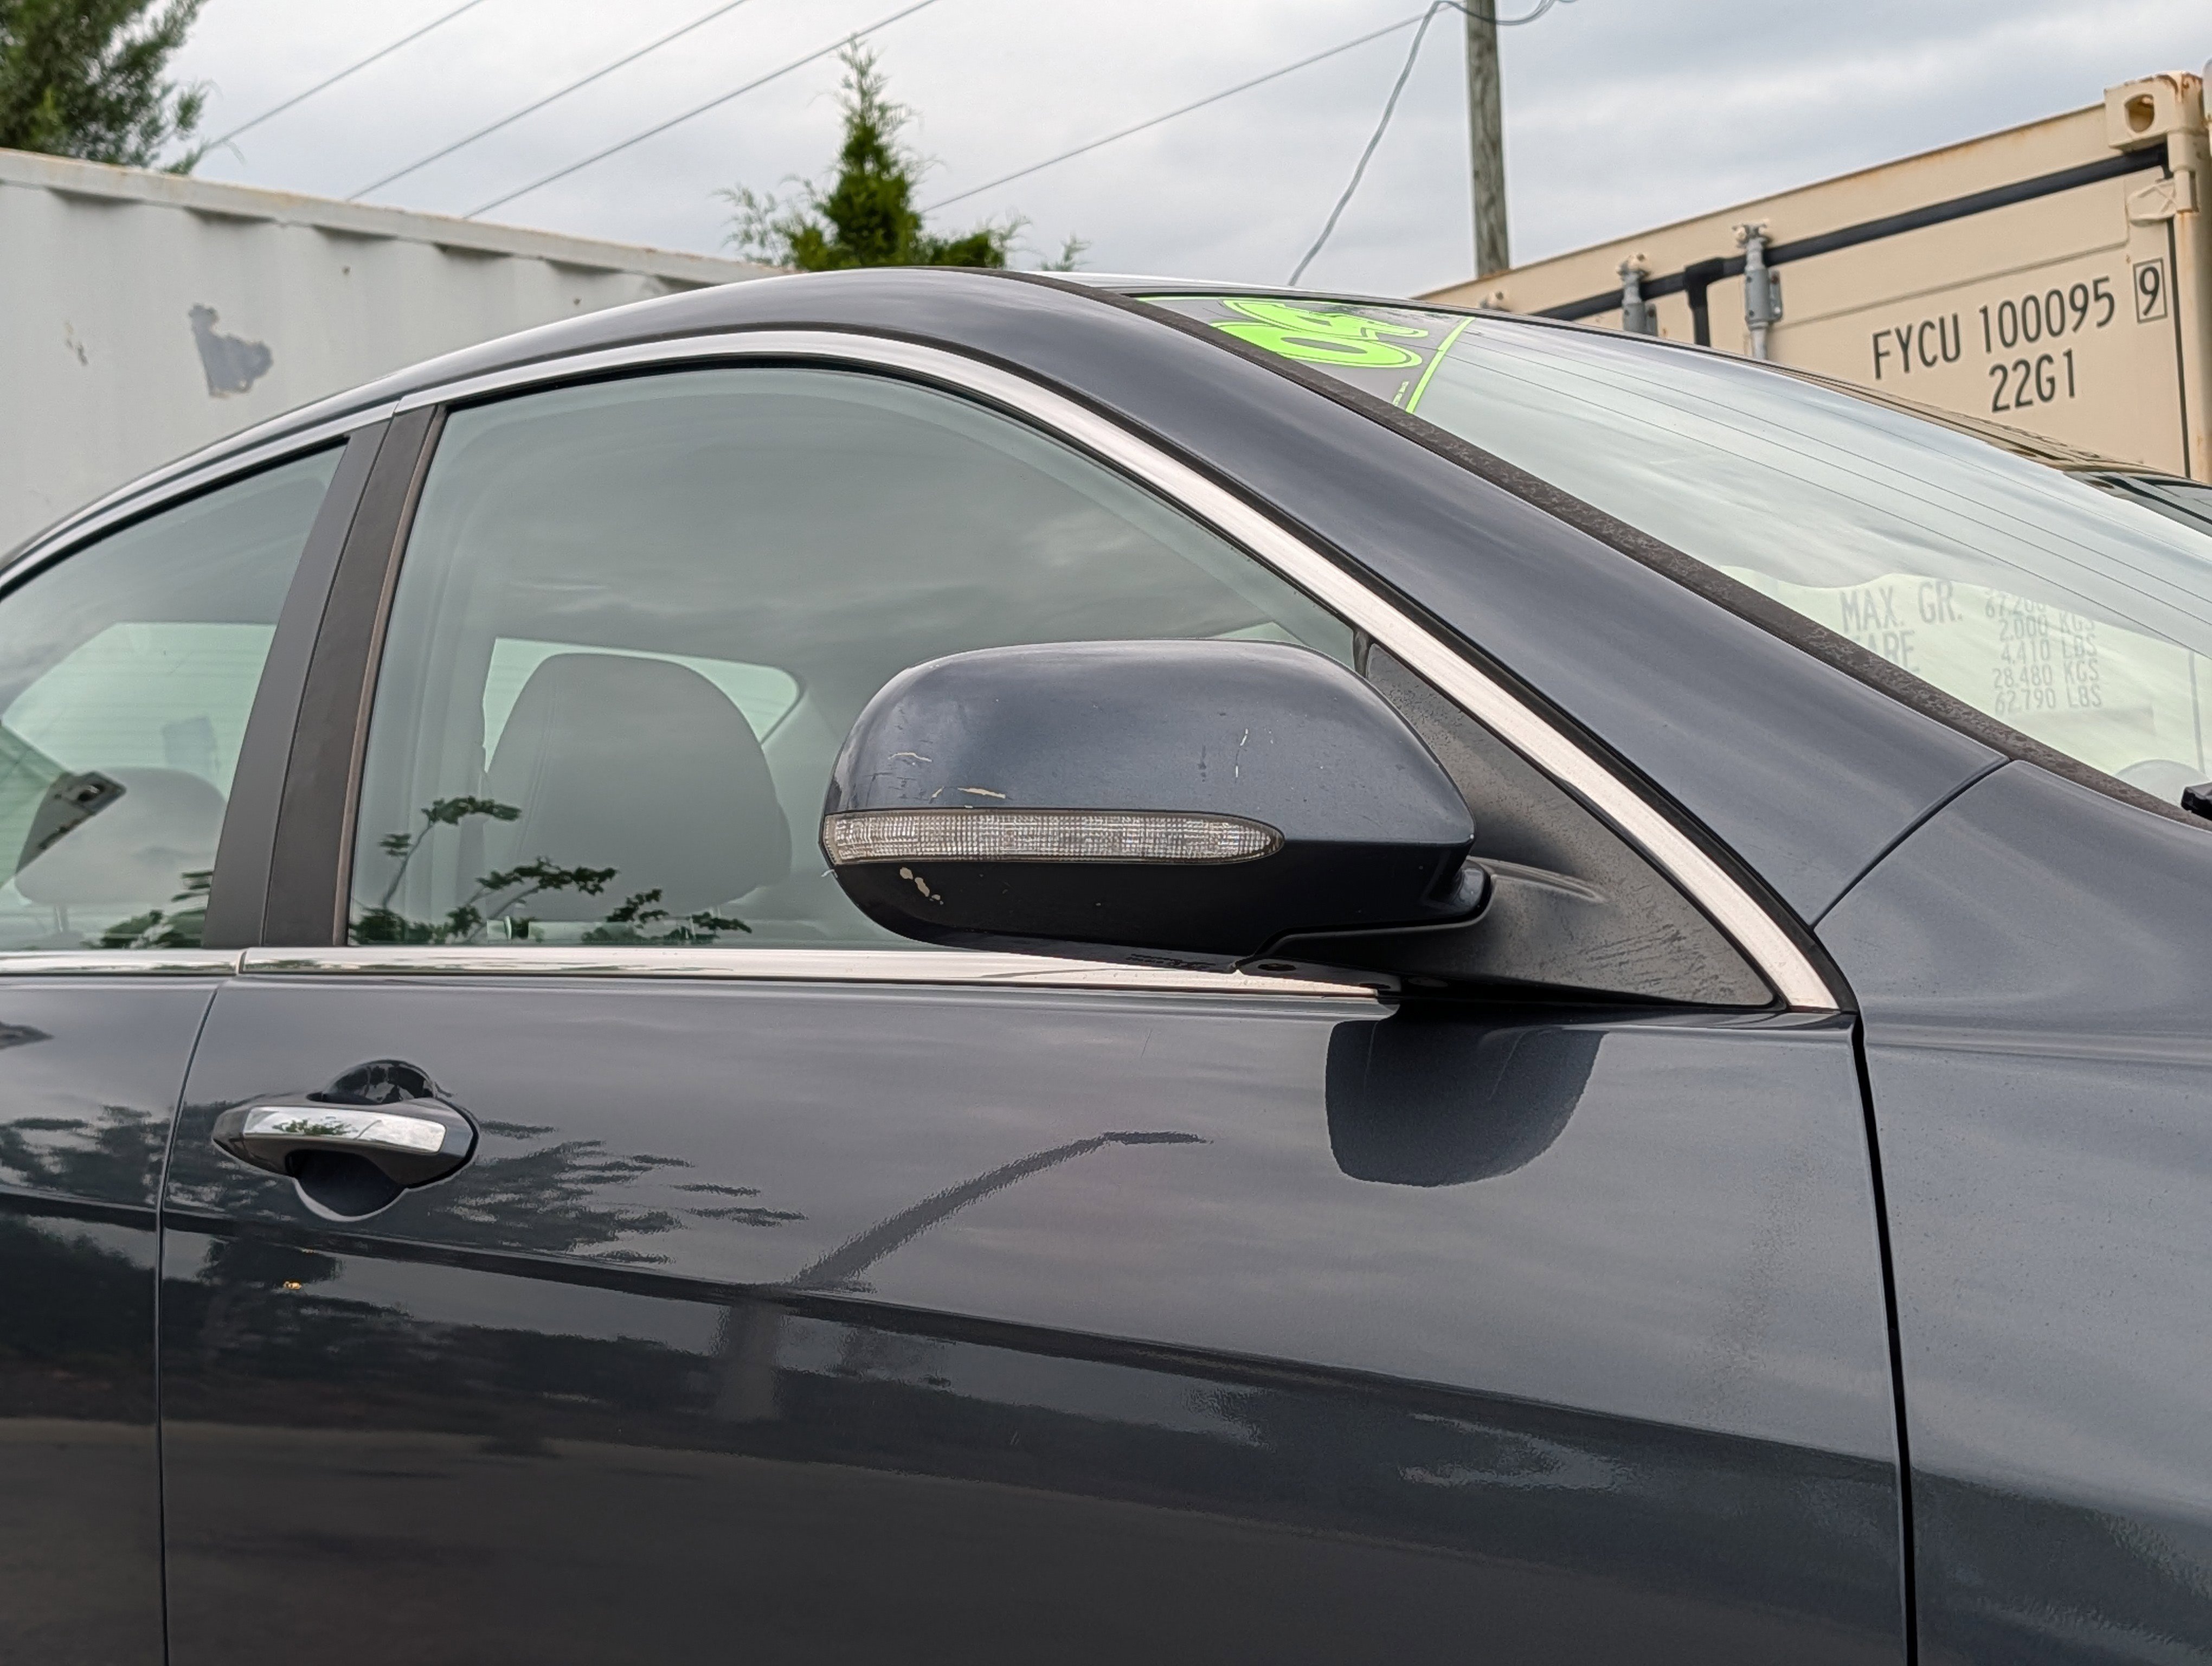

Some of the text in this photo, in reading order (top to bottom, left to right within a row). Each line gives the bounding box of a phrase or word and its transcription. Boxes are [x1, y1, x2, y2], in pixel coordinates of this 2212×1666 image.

[1872, 266, 2161, 381] FYCU 100095 9
[1988, 347, 2075, 413] 22G1
[1840, 580, 1963, 634] MAX. GR.
[1851, 629, 1921, 672] ARE
[2000, 633, 2098, 665] 4.410 LBS
[1992, 657, 2100, 689] 28.480 KGS
[1995, 682, 2102, 716] 62.790 LBS
